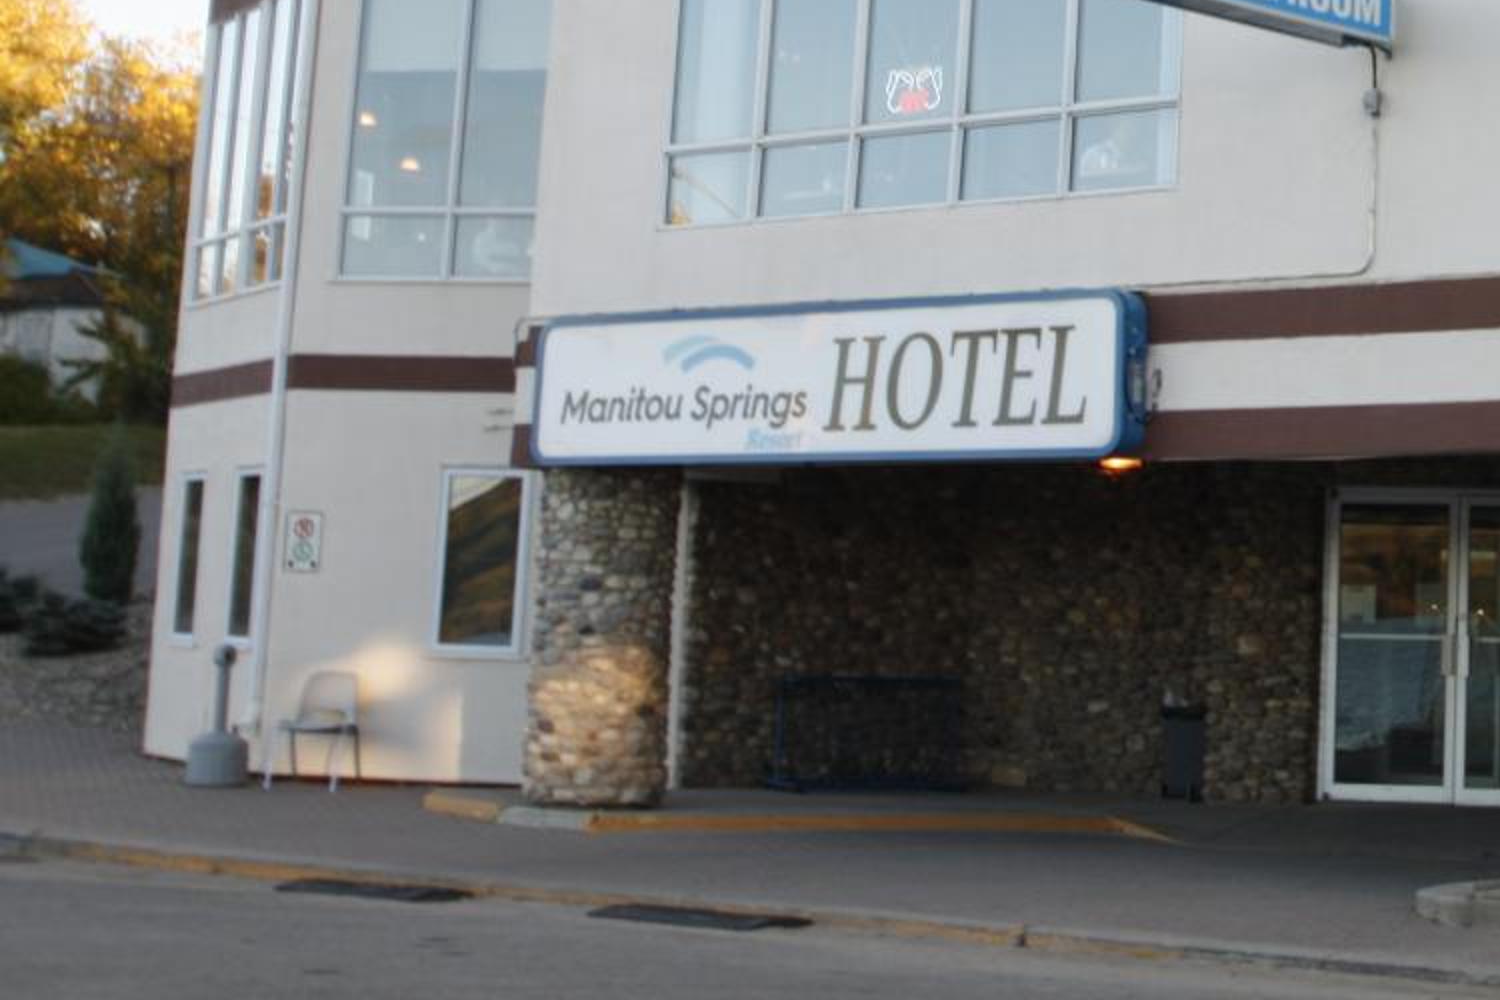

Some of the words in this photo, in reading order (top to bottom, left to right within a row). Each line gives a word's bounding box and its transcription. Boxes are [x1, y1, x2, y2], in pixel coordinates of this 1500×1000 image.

[560, 386, 683, 425] Manitou
[690, 384, 807, 430] Springs
[822, 325, 1087, 431] HOTEL
